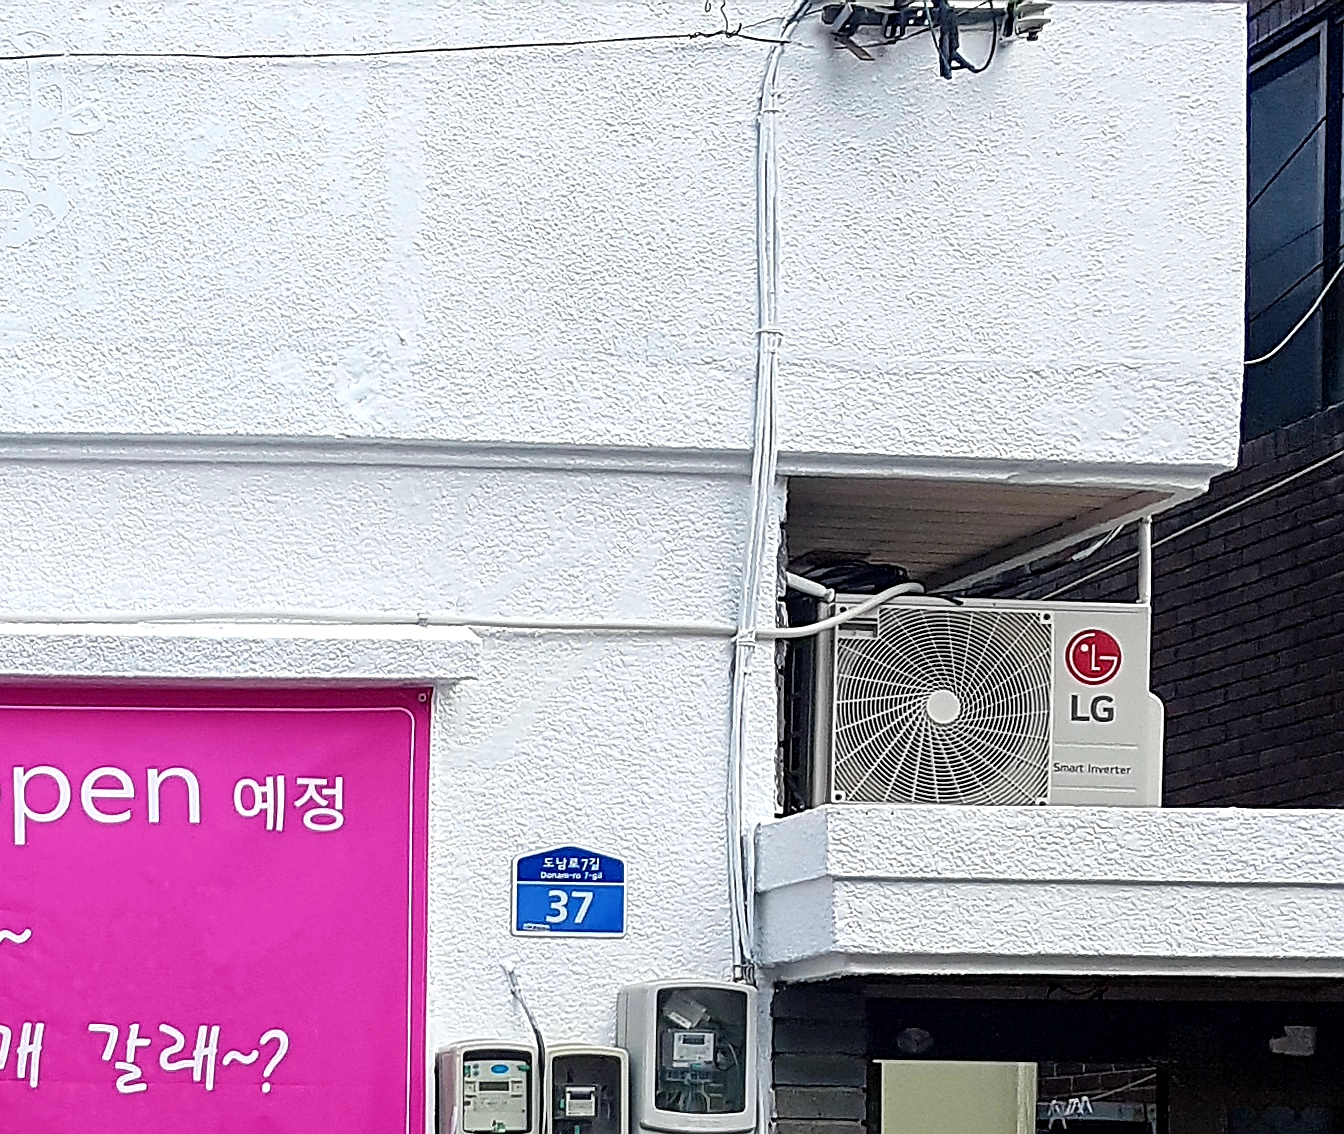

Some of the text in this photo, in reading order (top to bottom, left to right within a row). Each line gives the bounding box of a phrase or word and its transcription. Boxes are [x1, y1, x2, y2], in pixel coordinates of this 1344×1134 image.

[1070, 694, 1114, 723] LG
[1053, 762, 1132, 775] Smart Inverter
[233, 775, 345, 832] 예정
[545, 889, 593, 924] 37
[88, 1023, 290, 1094] 갈래~?
